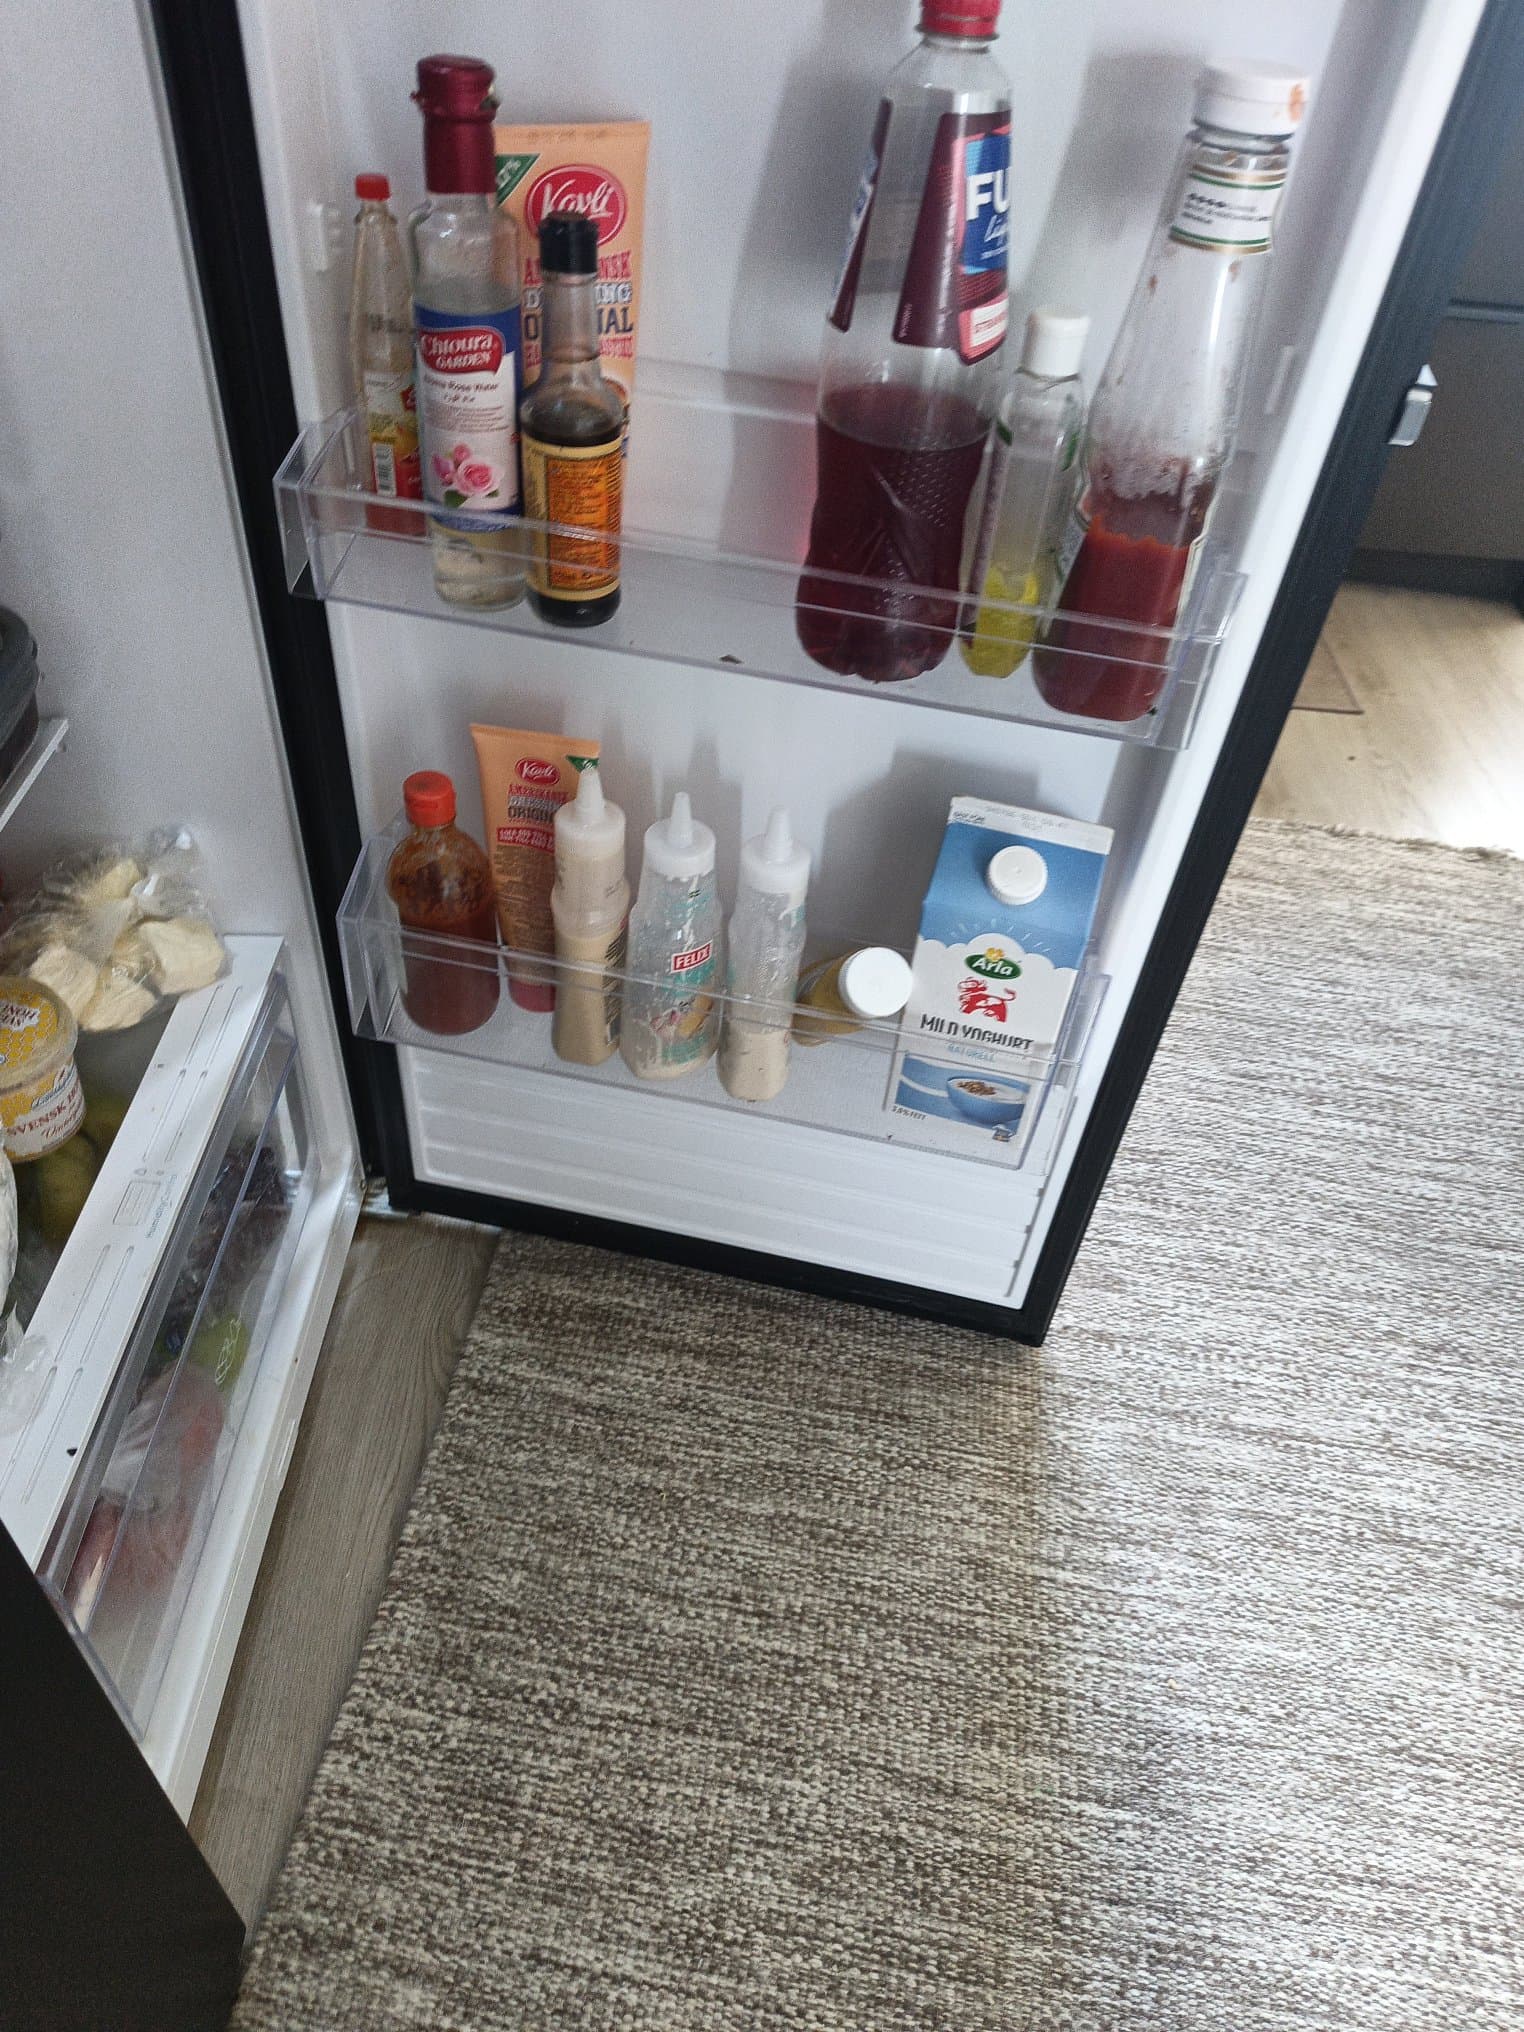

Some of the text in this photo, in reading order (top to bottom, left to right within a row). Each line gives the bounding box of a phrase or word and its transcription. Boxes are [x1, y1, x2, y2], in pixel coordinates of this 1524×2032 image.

[541, 179, 614, 221] Kavli
[965, 167, 1010, 221] FU
[435, 351, 492, 369] GARDEN
[521, 761, 555, 779] Kavli
[675, 944, 712, 969] FELIX
[972, 956, 1014, 976] Arla
[920, 1013, 1035, 1050] MILD YOGHURT
[7, 1103, 67, 1137] SVENSK
